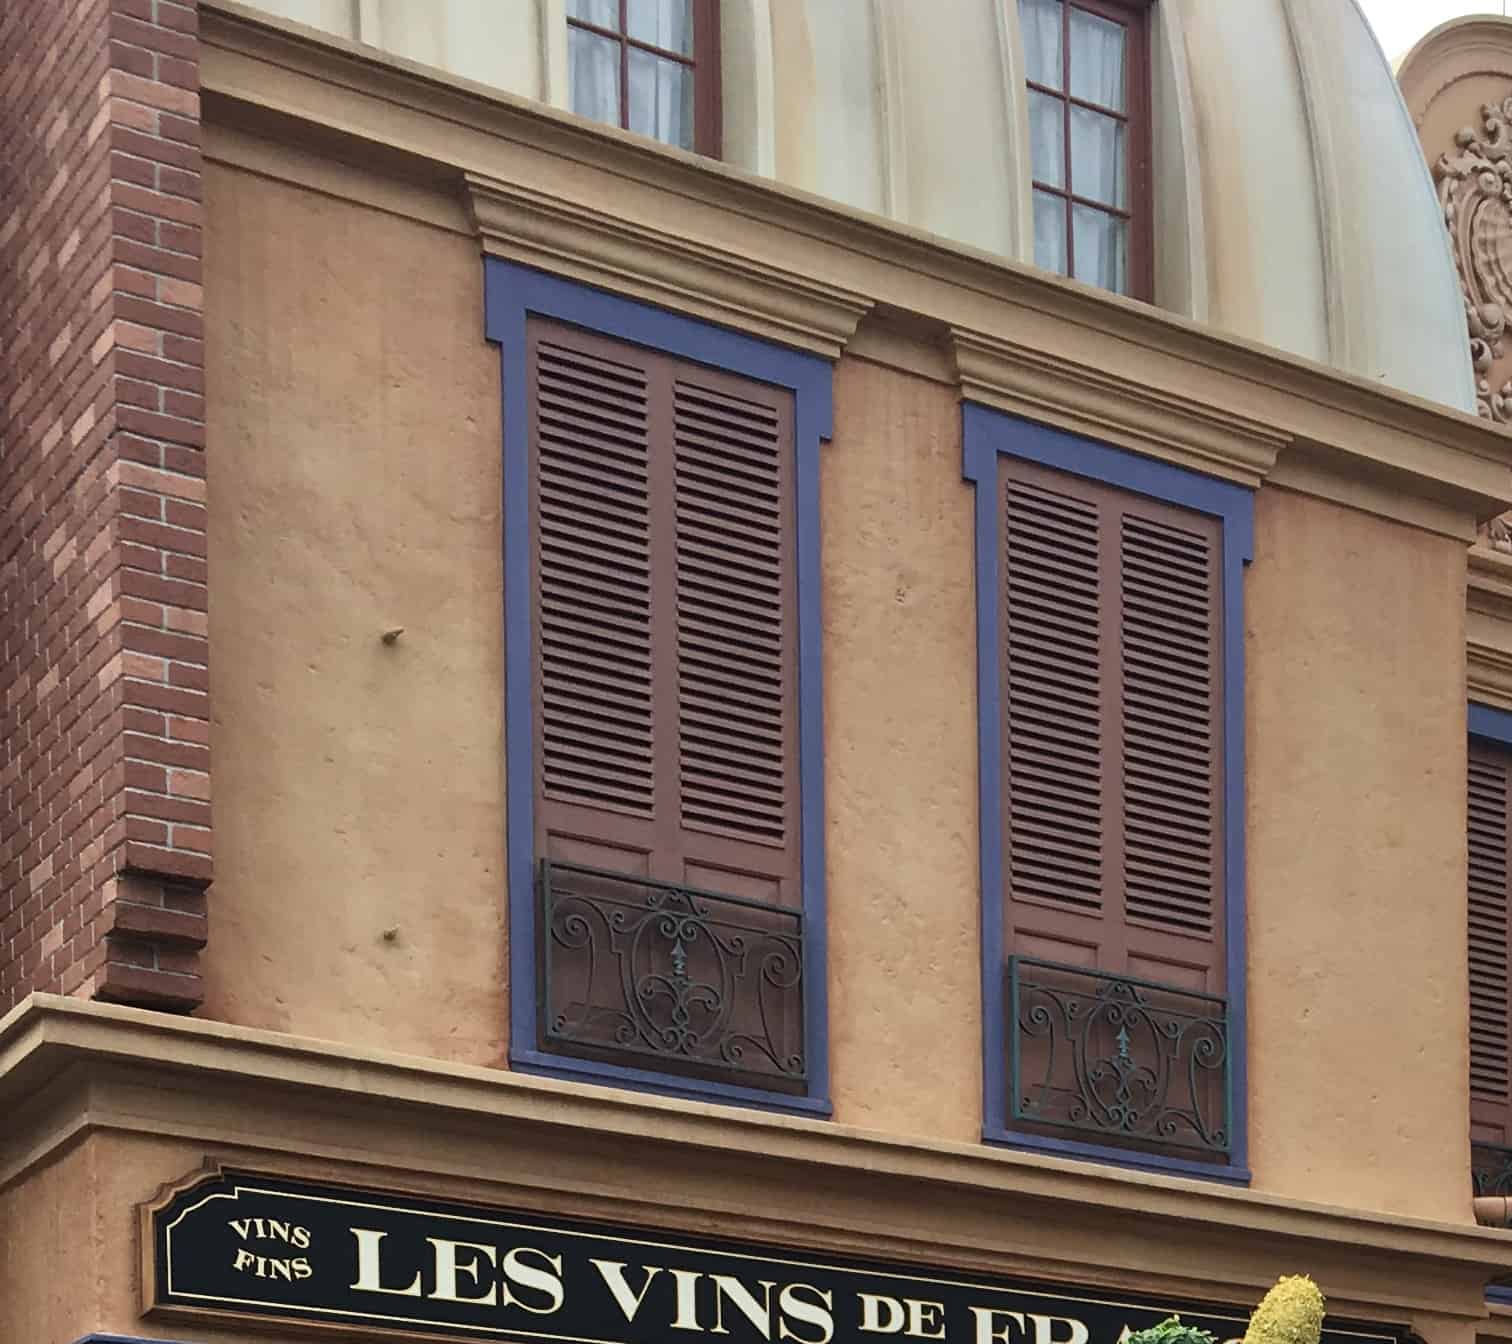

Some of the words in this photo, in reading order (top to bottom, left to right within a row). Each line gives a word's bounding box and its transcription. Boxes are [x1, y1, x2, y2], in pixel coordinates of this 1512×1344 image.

[228, 1218, 312, 1249] VINS
[232, 1248, 313, 1281] FINS
[349, 1227, 565, 1314] LES
[856, 1292, 946, 1340] DE
